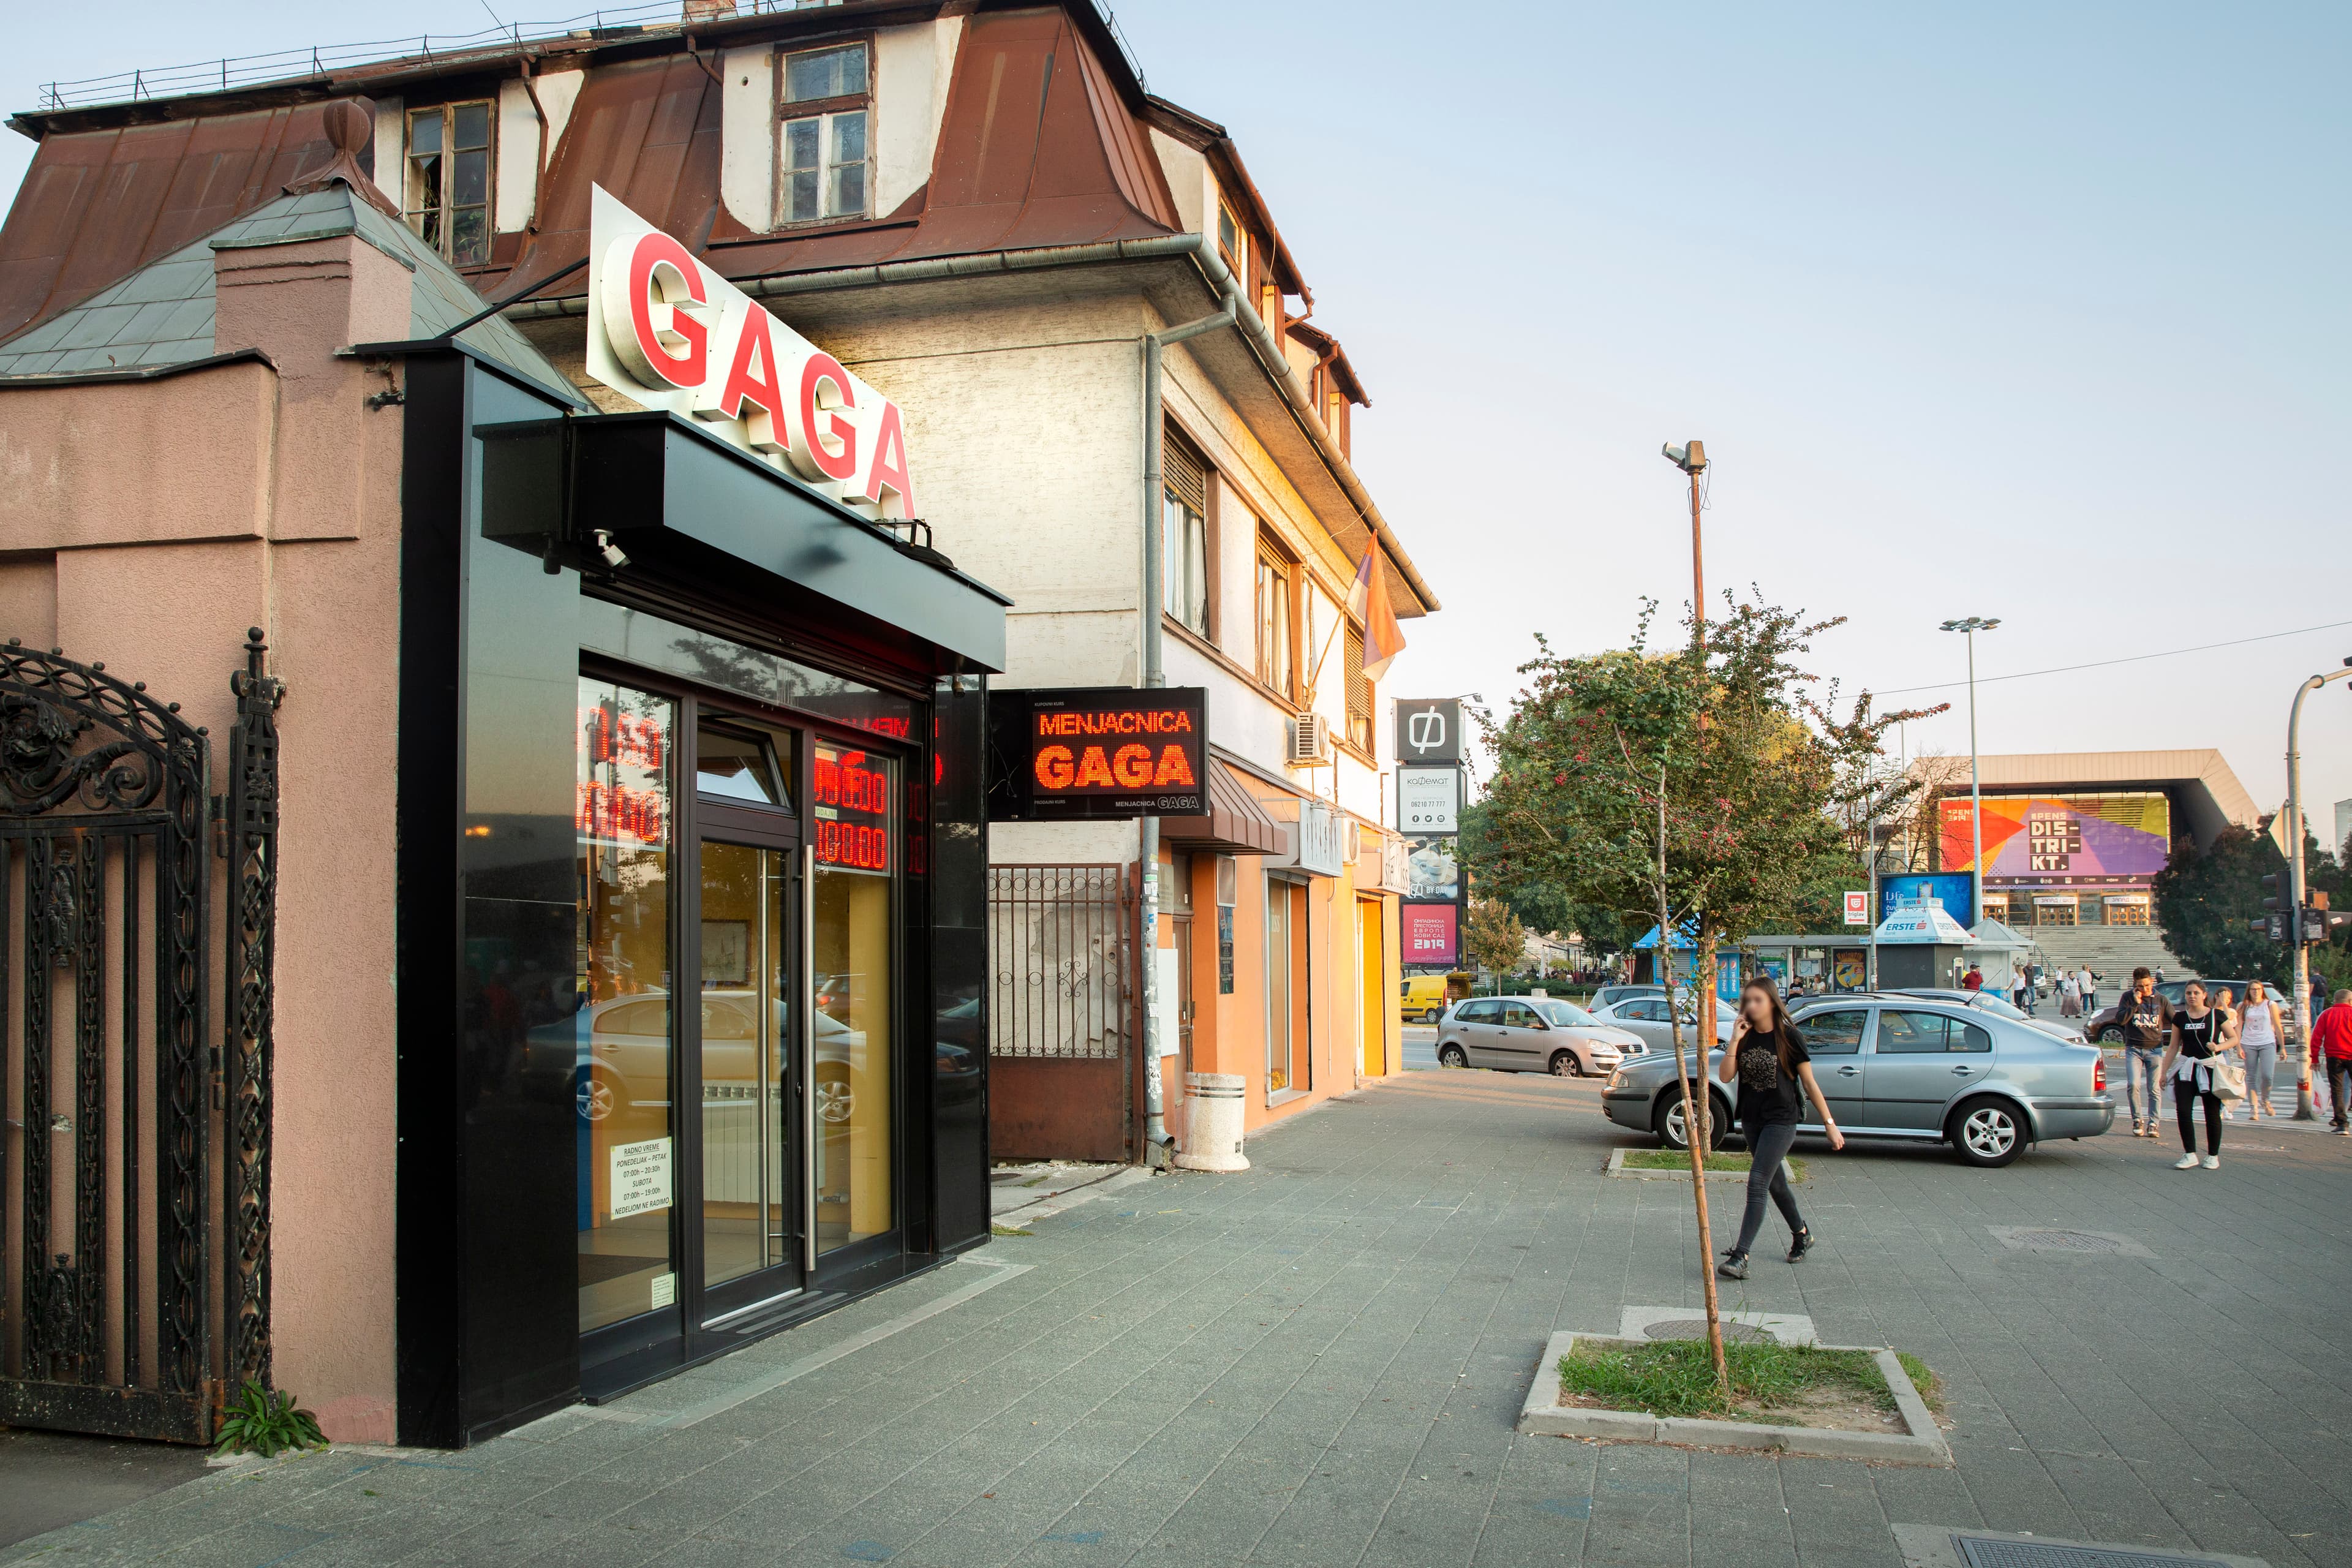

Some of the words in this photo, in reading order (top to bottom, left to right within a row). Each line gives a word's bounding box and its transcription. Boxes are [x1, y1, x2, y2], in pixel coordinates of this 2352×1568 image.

[629, 232, 915, 519] GAGA
[1040, 711, 1191, 735] MENJACNICA
[1035, 744, 1195, 789] GAGA
[1158, 796, 1199, 809] GAGA
[2032, 821, 2079, 836] DIS-
[2032, 839, 2079, 853] TRI-
[624, 1147, 642, 1155] RADNO
[643, 1143, 660, 1152] VREME
[617, 1156, 647, 1167] PONEDELJAK
[652, 1153, 666, 1161] PETAK
[624, 1169, 640, 1178] 07:00h
[645, 1165, 660, 1174] 20:30h
[632, 1177, 652, 1188] SUBOTA
[624, 1191, 640, 1200] 07:00h
[645, 1187, 661, 1196] 19:00h
[615, 1203, 641, 1215] NEDELJOM
[650, 1197, 669, 1207] RADIMO
